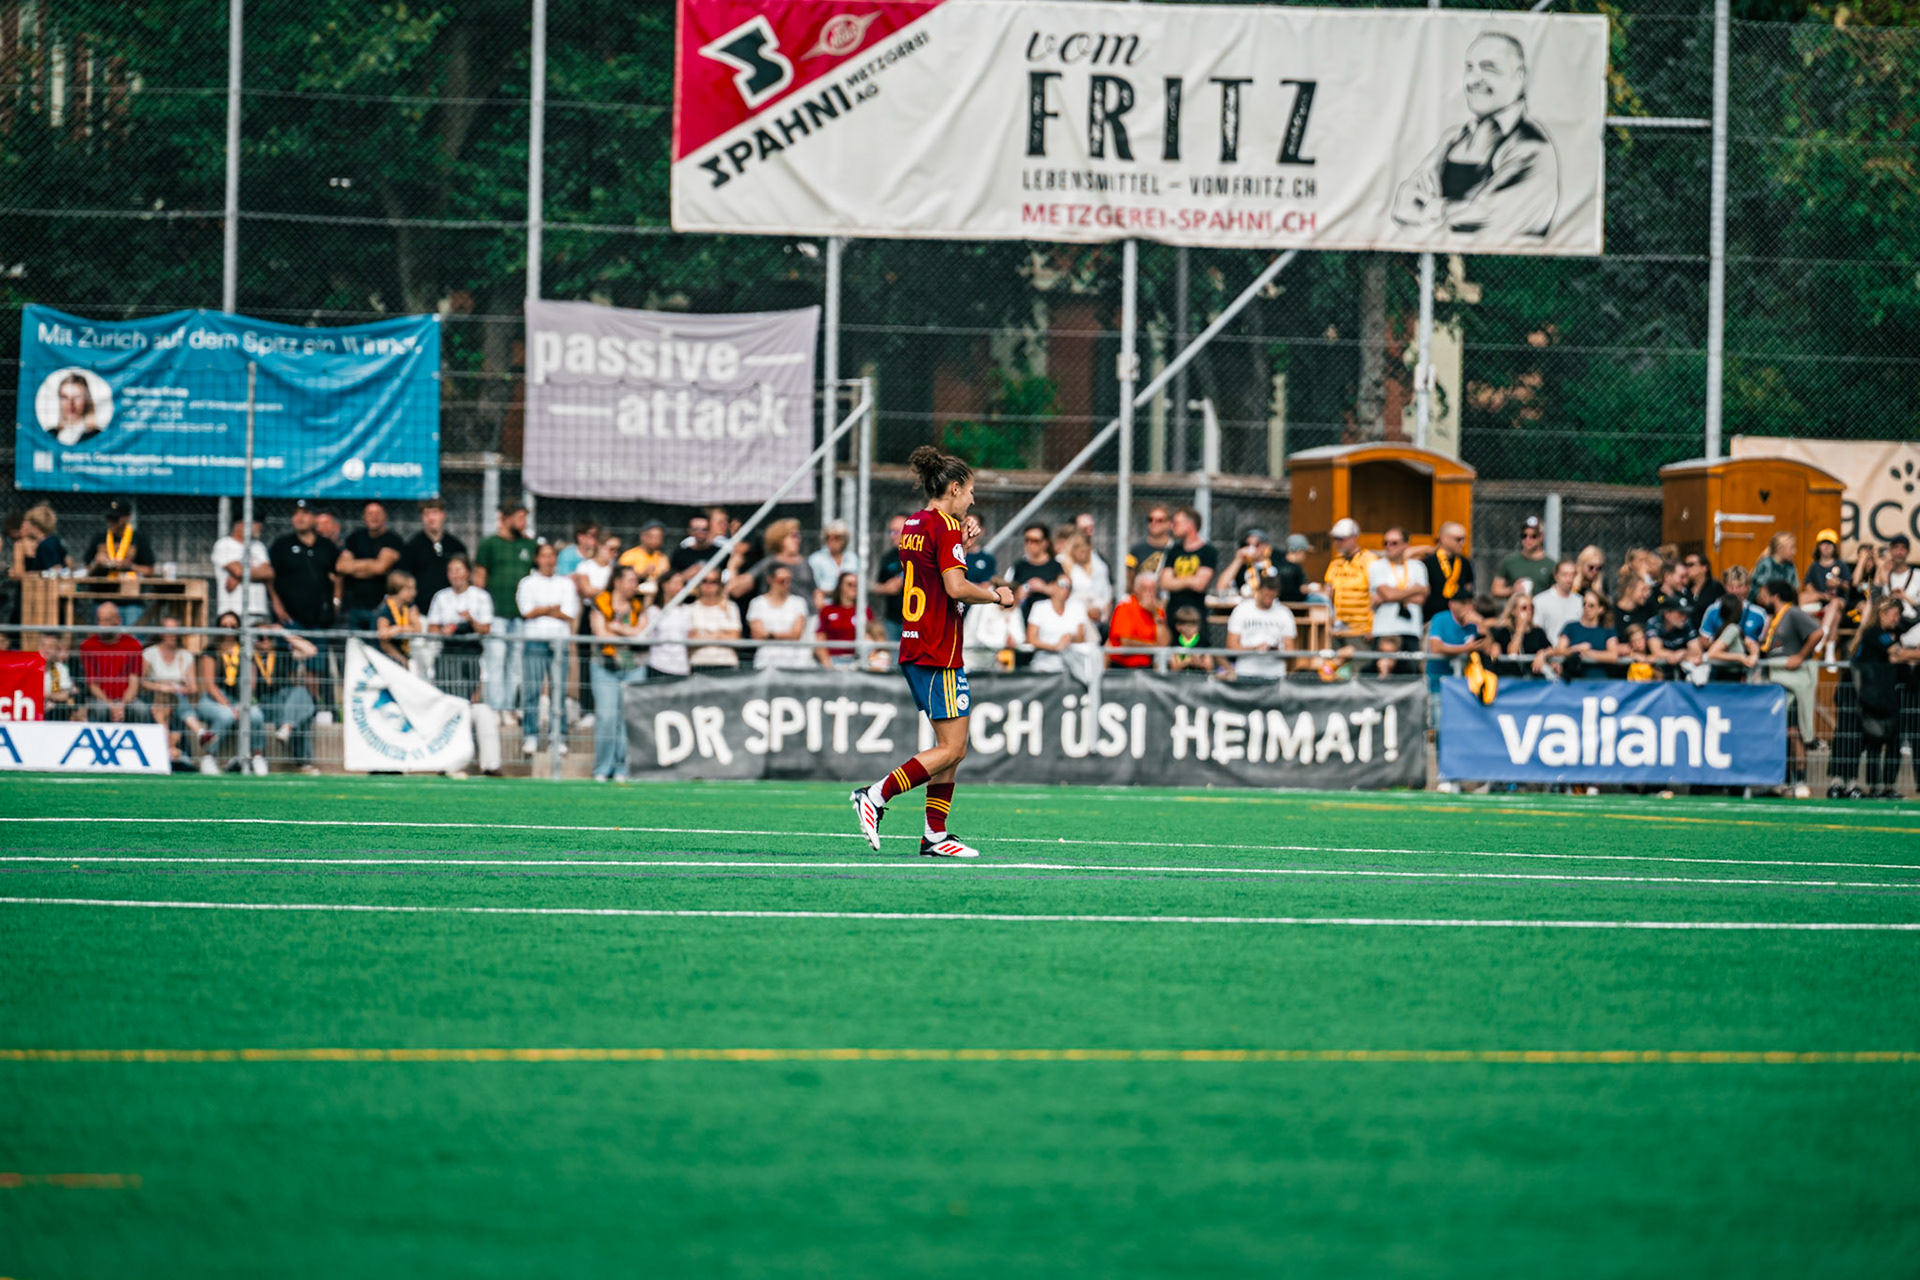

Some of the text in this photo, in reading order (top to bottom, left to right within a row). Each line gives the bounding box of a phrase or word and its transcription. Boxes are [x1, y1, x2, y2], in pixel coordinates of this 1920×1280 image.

[1025, 29, 1147, 66] vom
[855, 84, 880, 105] AG
[699, 84, 853, 189] SPAHNI
[1026, 70, 1318, 165] FRITZ
[1022, 169, 1160, 196] LEBENSMITTEL
[1189, 175, 1318, 199] VOMFRITZ.CH
[1022, 202, 1318, 234] METZGEREI-SPAHNI.CH
[37, 322, 73, 347] Mit
[189, 326, 239, 351] dem
[616, 383, 790, 440] attack
[1841, 499, 1920, 543] ac
[60, 727, 151, 767] AXA
[654, 705, 734, 767] DR
[741, 697, 898, 754] SPITZ
[1170, 704, 1398, 766] HEIMAT!
[1497, 695, 1733, 769] valiant
